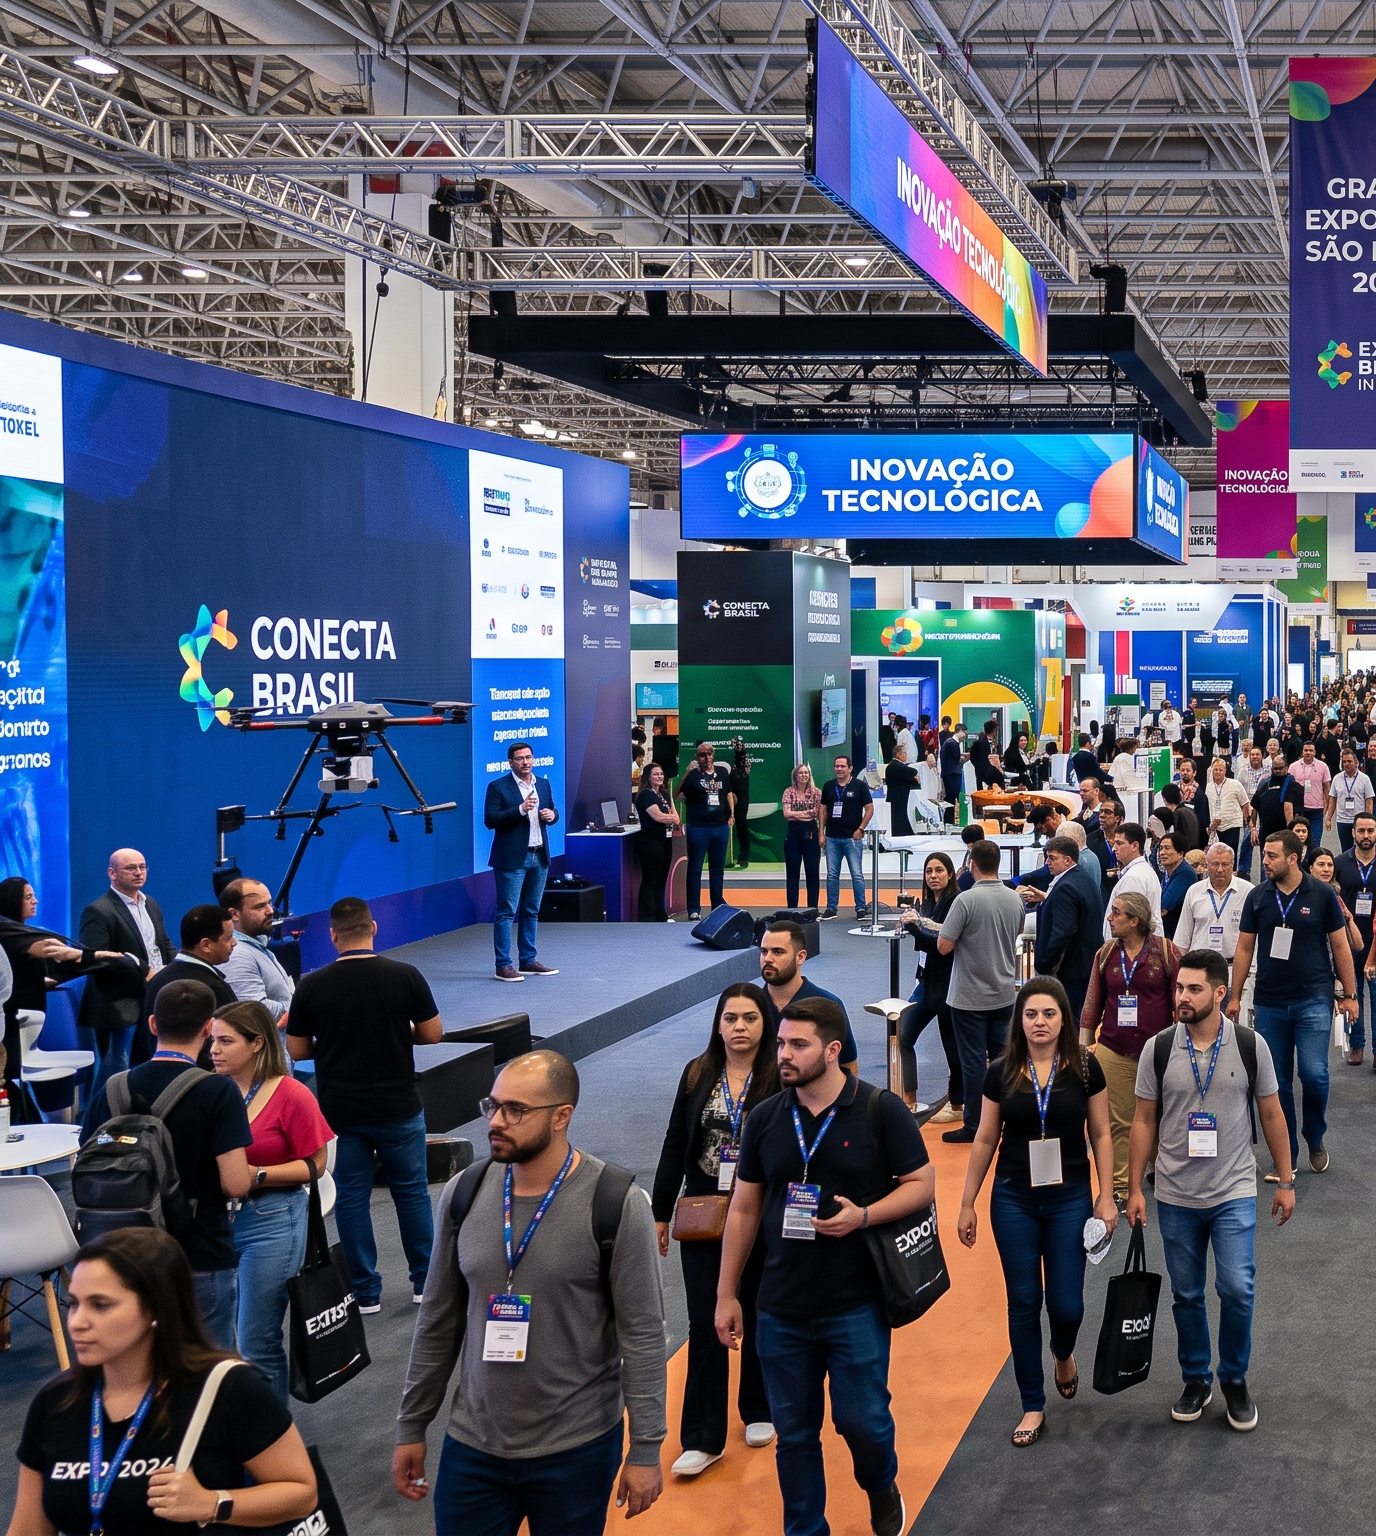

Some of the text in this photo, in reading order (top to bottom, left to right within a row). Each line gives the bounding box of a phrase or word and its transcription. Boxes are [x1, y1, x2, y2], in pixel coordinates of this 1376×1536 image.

[896, 156, 961, 256] INOVAÇÃO
[1305, 234, 1363, 262] SÃO
[850, 452, 1015, 489] INOVAÇÃO
[1224, 468, 1288, 483] INOVAÇÃO
[723, 602, 770, 610] CONECTA
[250, 616, 397, 661] CONECTA
